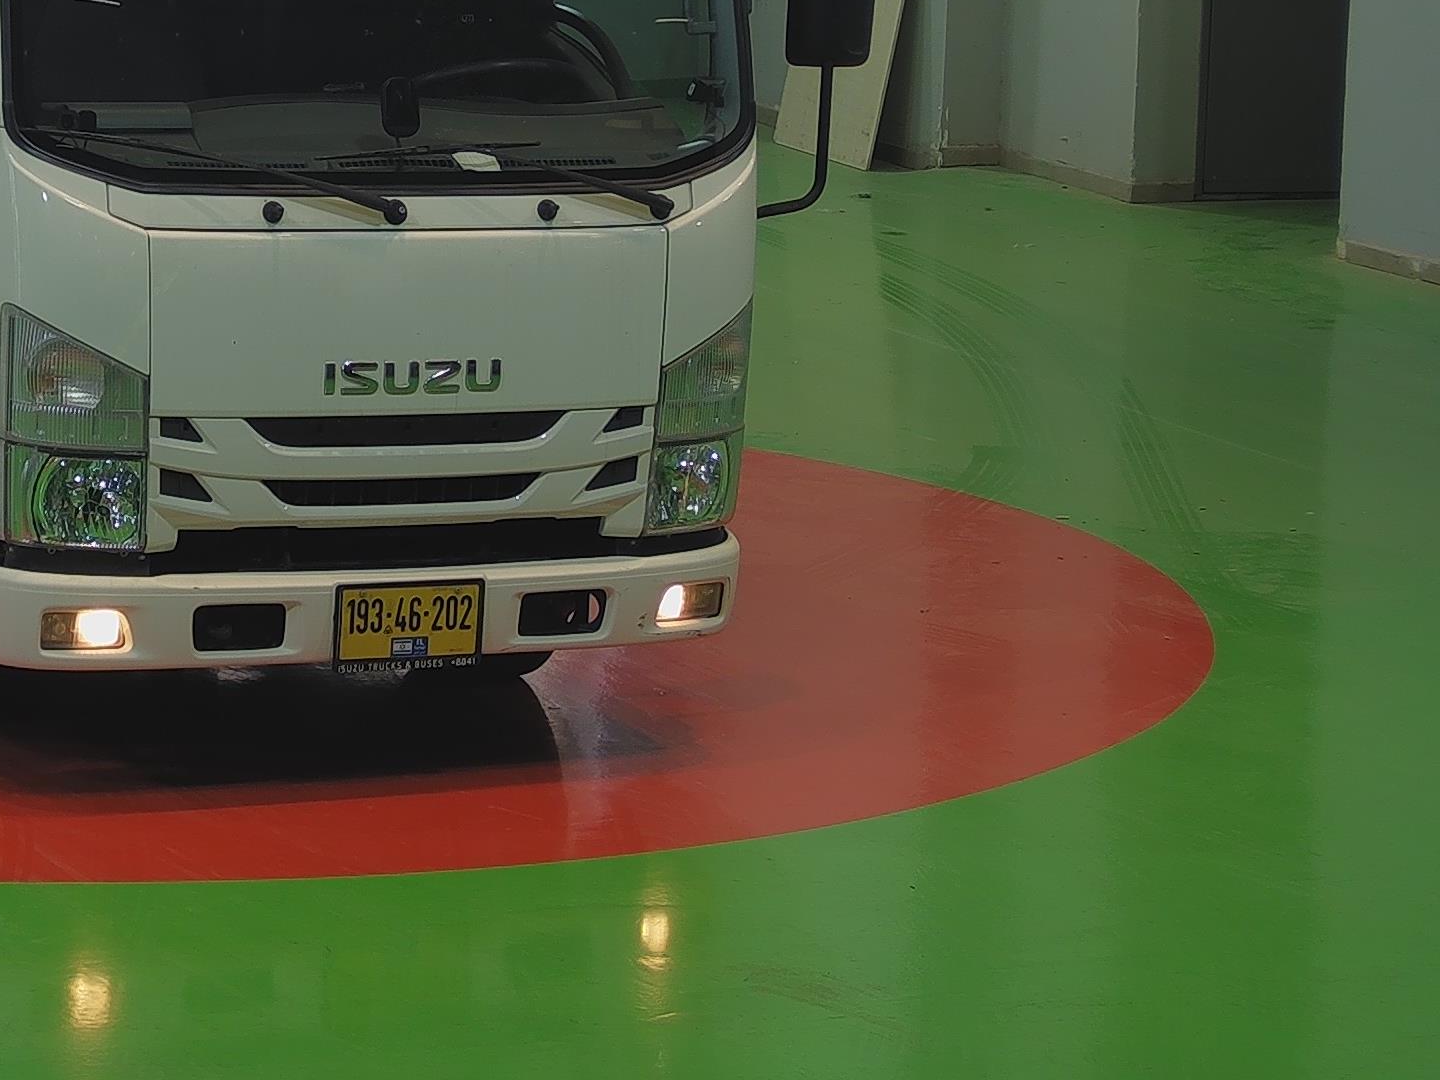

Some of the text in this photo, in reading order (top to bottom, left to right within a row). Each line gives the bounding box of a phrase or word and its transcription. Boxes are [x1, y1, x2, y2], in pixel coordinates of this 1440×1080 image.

[323, 358, 502, 396] ISUZU
[337, 663, 365, 674] ISUZU
[368, 661, 402, 672] TRUCKS
[414, 658, 444, 670] BUSES
